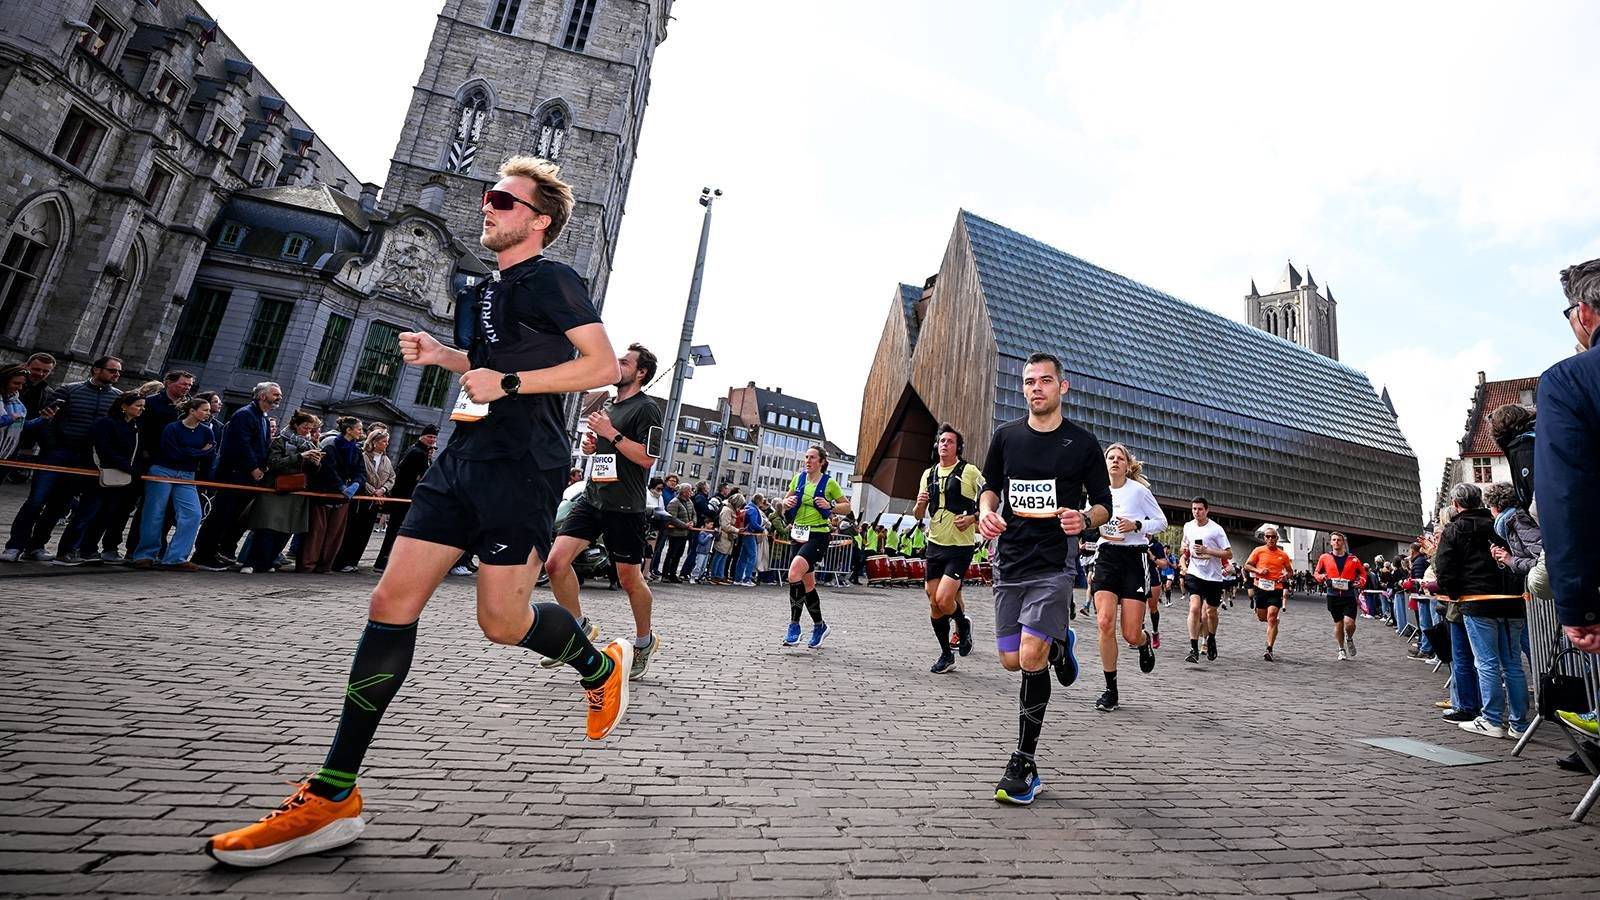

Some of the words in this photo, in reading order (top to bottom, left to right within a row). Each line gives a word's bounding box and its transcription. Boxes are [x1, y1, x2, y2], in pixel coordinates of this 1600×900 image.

[481, 287, 499, 343] KIPRUN
[1011, 483, 1052, 492] SOFICO
[1010, 495, 1055, 509] 24834
